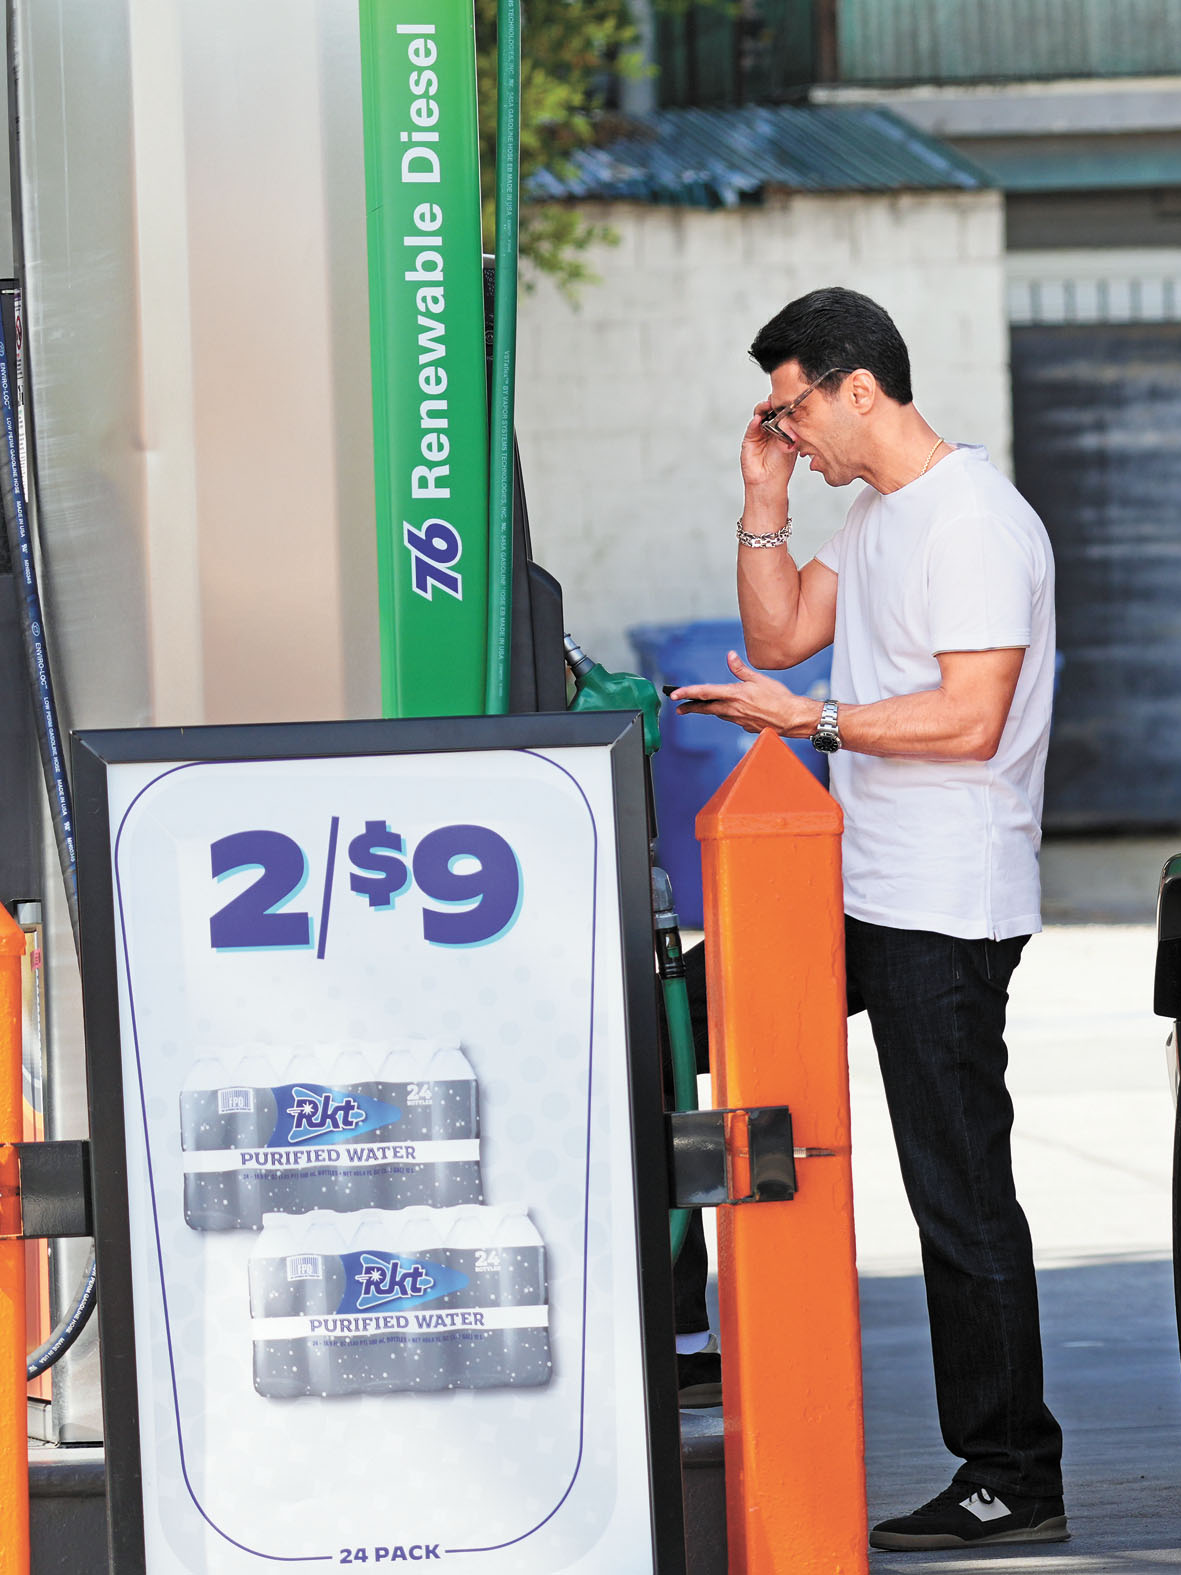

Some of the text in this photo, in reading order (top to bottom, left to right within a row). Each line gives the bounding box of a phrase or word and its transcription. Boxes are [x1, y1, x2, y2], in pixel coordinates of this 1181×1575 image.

[396, 23, 462, 601] 76 Renewable Diesel
[502, 386, 509, 394] BY
[10, 449, 18, 477] GASOLINE
[45, 711, 53, 727] PERM
[48, 728, 57, 756] GASOLINE
[209, 816, 523, 960] 2/$9
[407, 1084, 432, 1100] 24
[292, 1093, 356, 1130] Rkt
[240, 1145, 416, 1166] PURIFIED WATER
[475, 1250, 500, 1267] 24
[361, 1260, 424, 1297] Rkt
[76, 1292, 90, 1320] GASOLINE
[66, 1318, 77, 1334] HOSE
[310, 1312, 485, 1333] PURIFIED WATER
[54, 1337, 65, 1352] MADE
[39, 1354, 50, 1364] USA
[340, 1544, 441, 1564] 24 PACK
